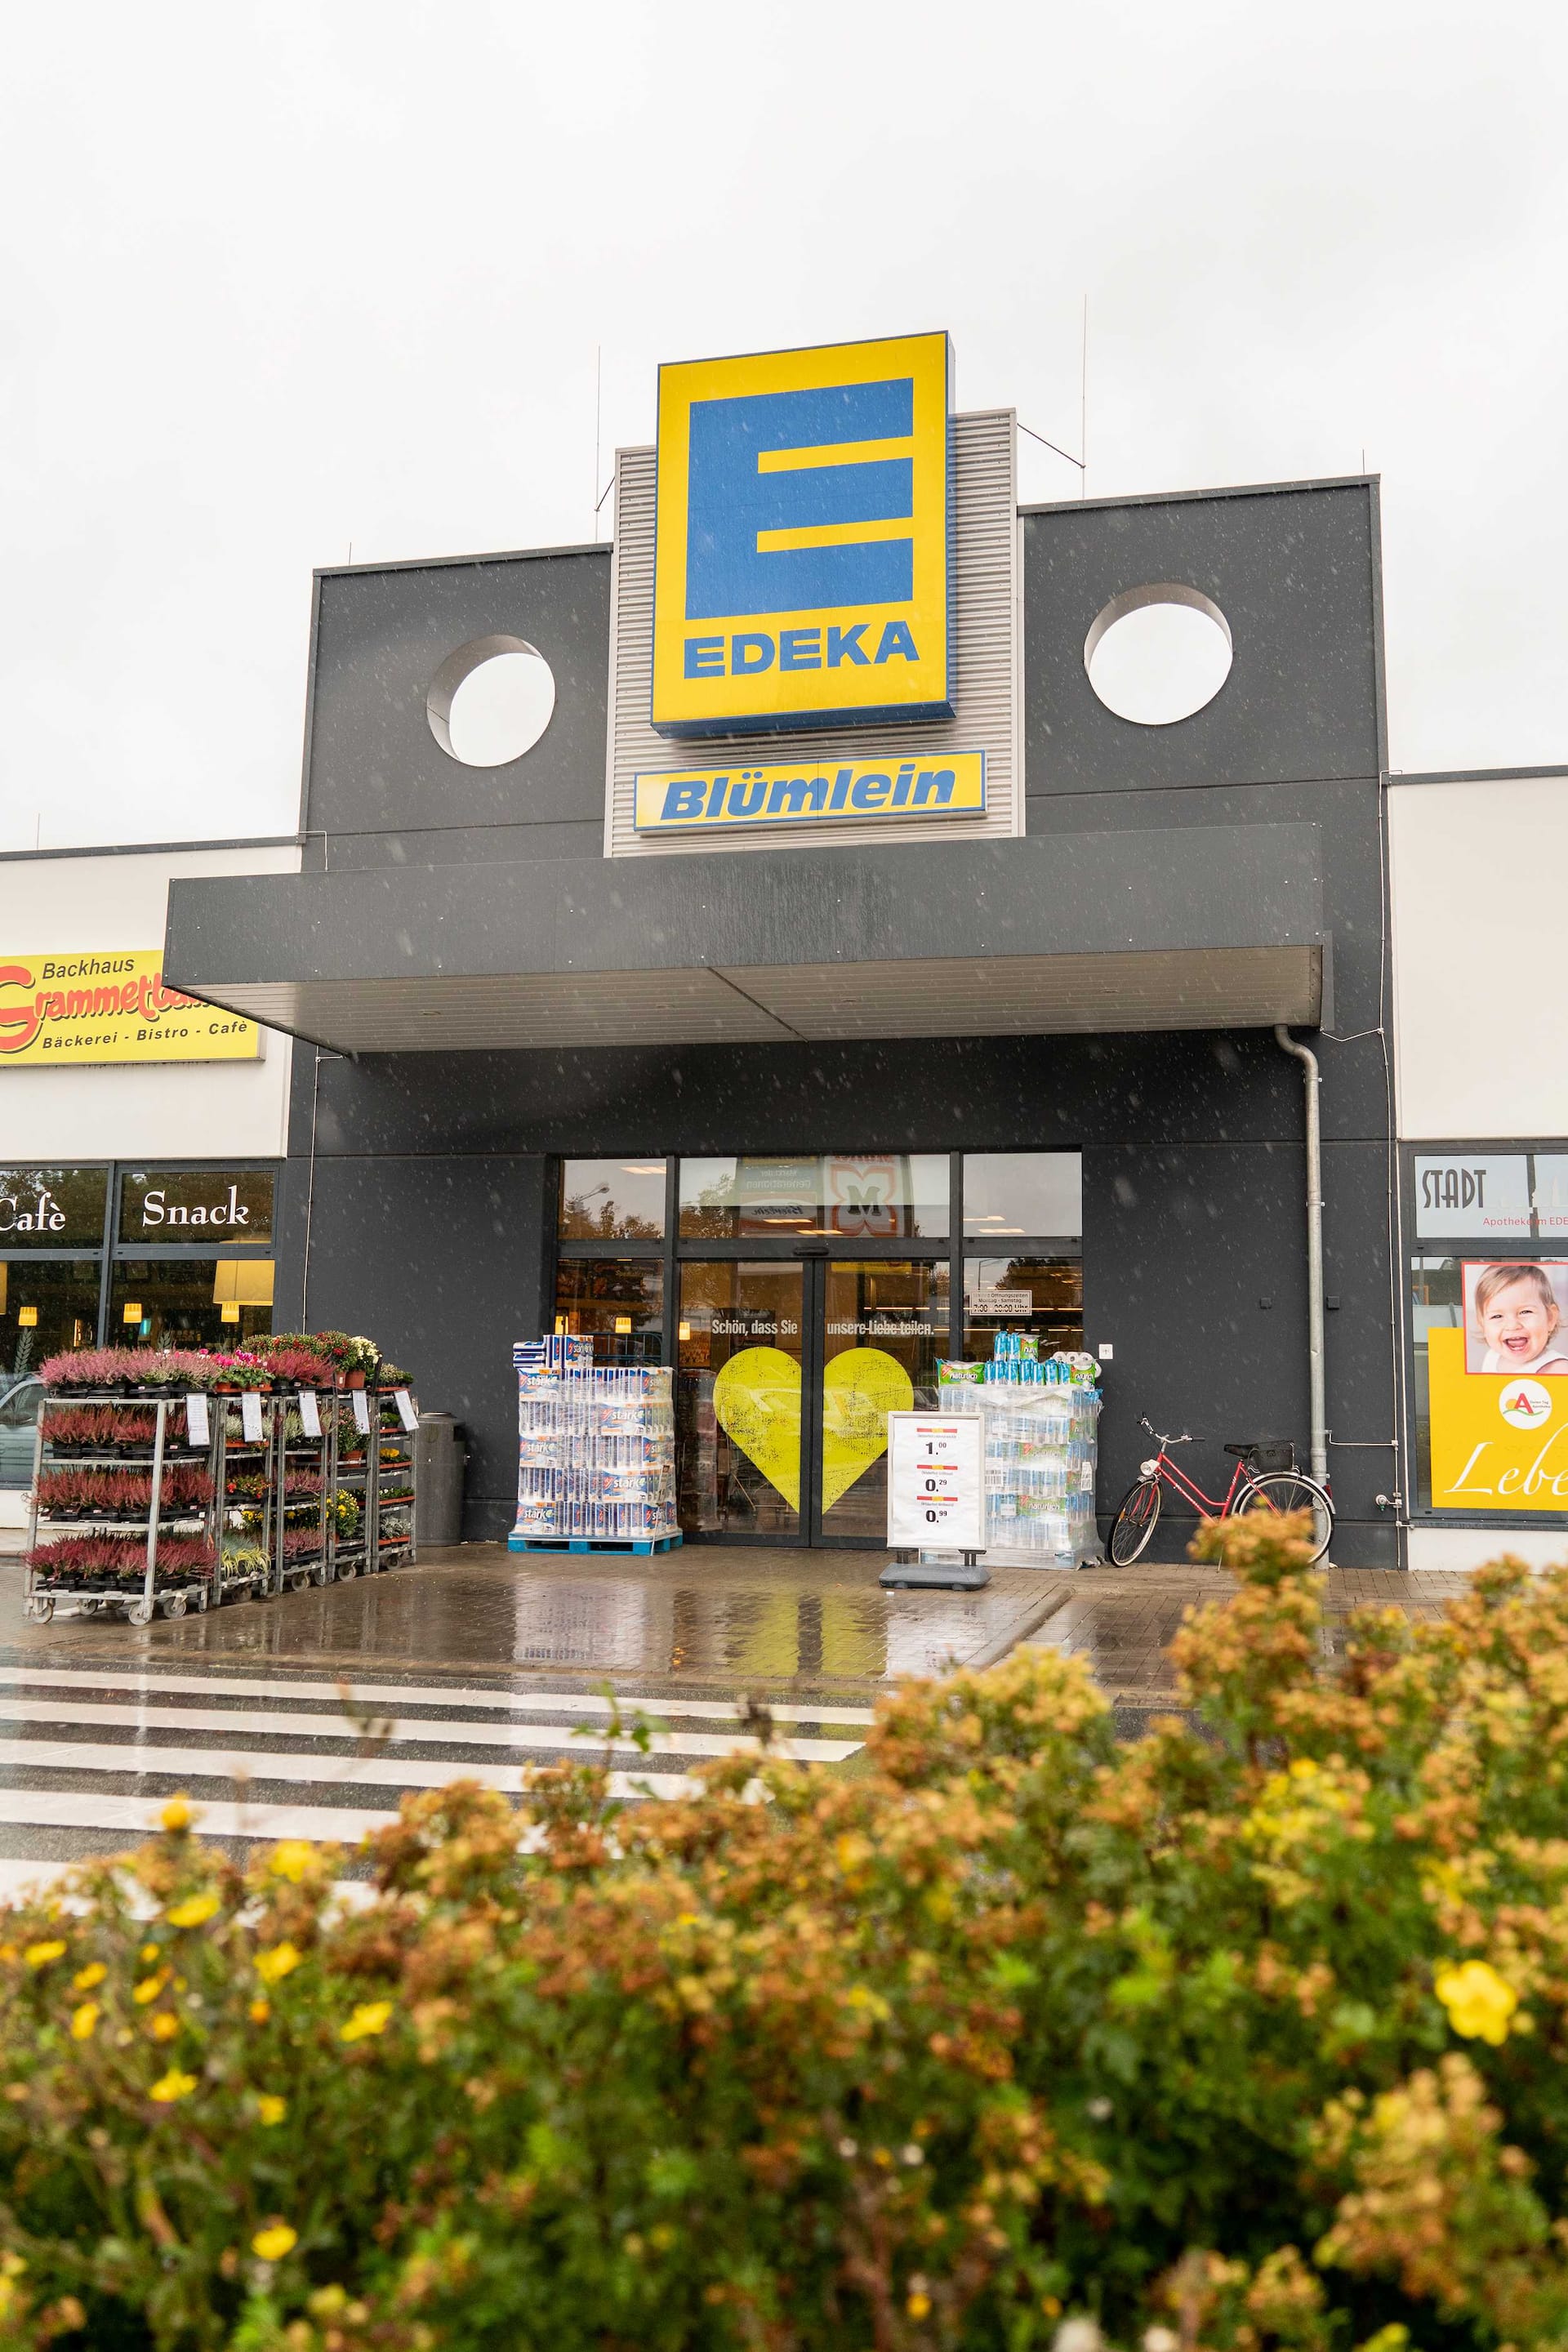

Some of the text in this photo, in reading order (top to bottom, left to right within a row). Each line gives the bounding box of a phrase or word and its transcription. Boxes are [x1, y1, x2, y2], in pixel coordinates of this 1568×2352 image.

[684, 621, 920, 679] EDEKA
[660, 764, 956, 820] Blümlein
[42, 958, 135, 980] Backhaus
[42, 1031, 118, 1049] Bäckerei
[137, 1027, 189, 1041] Bistro
[208, 1021, 248, 1036] Cafè
[1422, 1168, 1486, 1209] STADT
[142, 1184, 249, 1227] Snack
[1482, 1217, 1532, 1227] Apotheke
[711, 1319, 798, 1337] Schön, dass Sie
[826, 1321, 935, 1334] unsere Liebe teilen.
[925, 1479, 947, 1492] 0.29
[925, 1510, 947, 1523] 0.99
